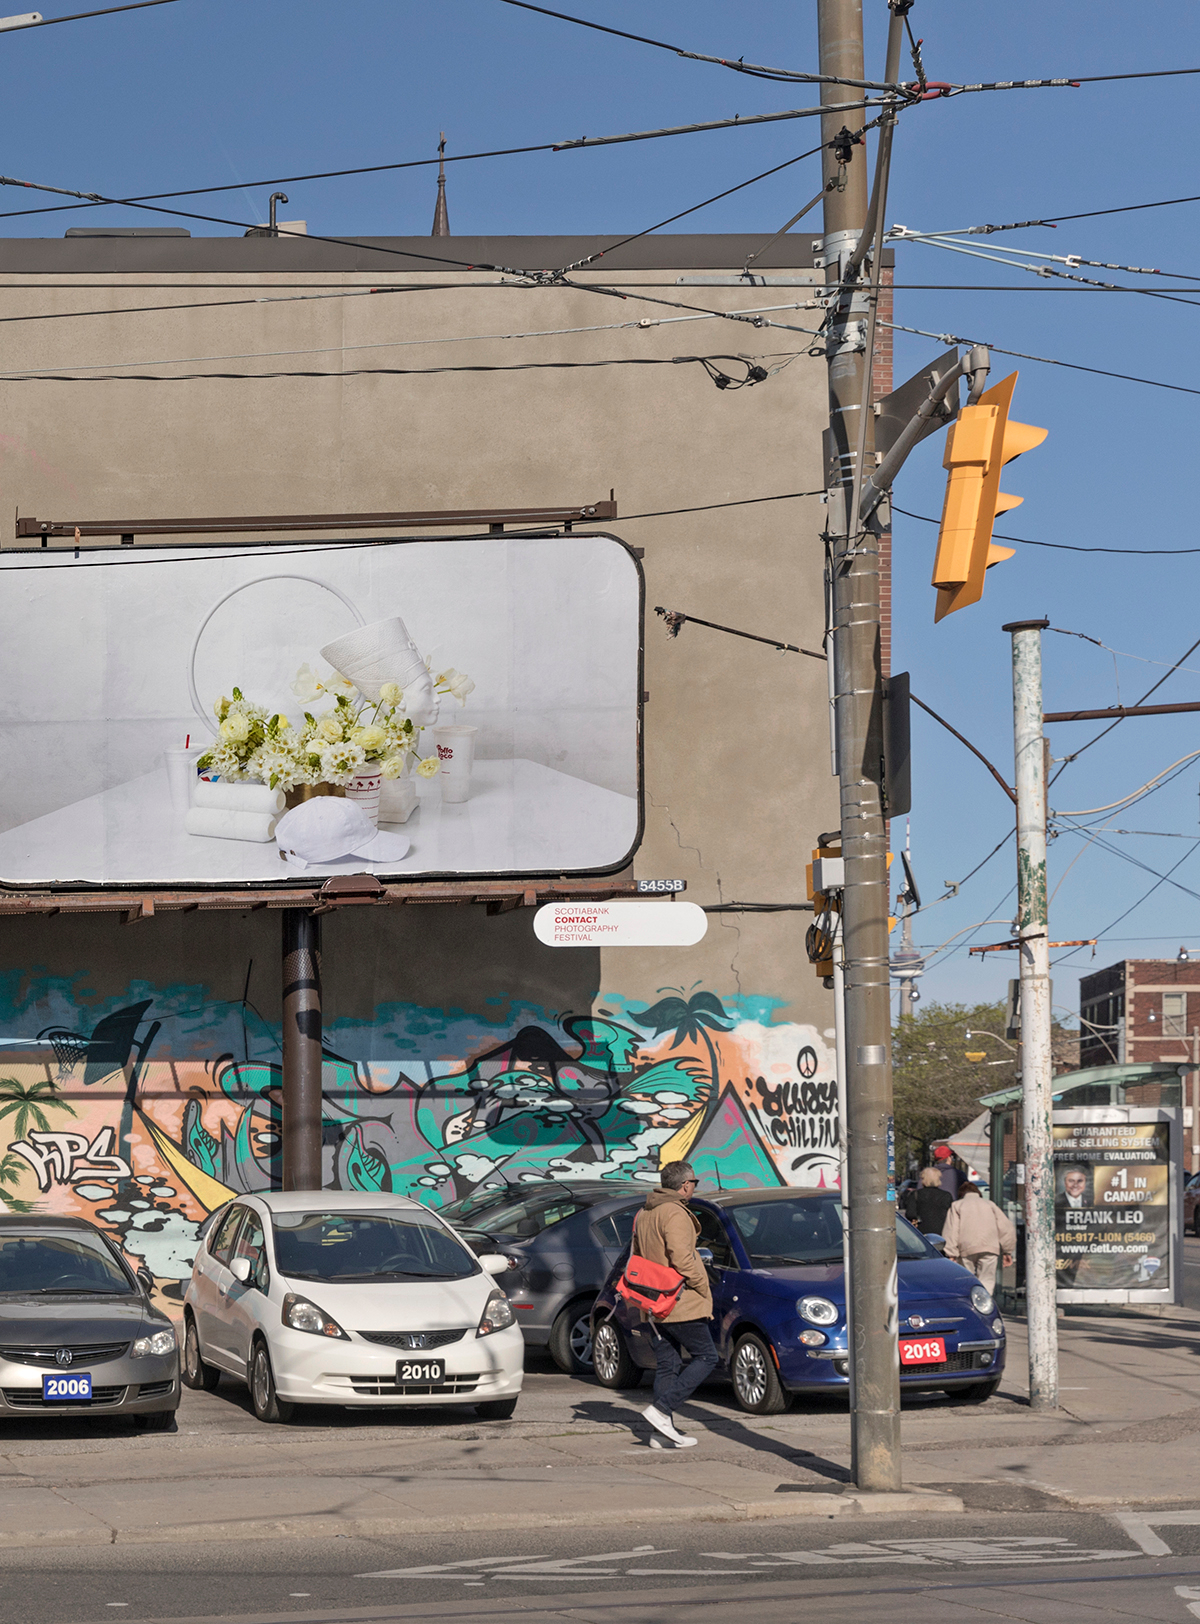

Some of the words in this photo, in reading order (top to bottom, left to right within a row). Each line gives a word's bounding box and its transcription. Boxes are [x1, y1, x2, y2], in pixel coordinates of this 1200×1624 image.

[640, 880, 684, 892] 5455B
[554, 907, 610, 915] SCOTIABANK
[554, 916, 598, 924] CONTACT
[554, 925, 619, 933] PHOTOGRAPHY
[554, 933, 593, 941] FESTIVAL
[1073, 1126, 1137, 1137] GUARANTEED
[1079, 1138, 1119, 1148] SELLING
[1121, 1137, 1160, 1147] SYSTEM
[1053, 1152, 1075, 1161] FREE
[1076, 1152, 1101, 1161] HOME
[1103, 1151, 1157, 1161] EVALUATION
[1110, 1168, 1128, 1189] #1
[1134, 1177, 1147, 1188] IN
[1065, 1210, 1113, 1224] FRANK
[1116, 1210, 1144, 1224] LEO
[1054, 1232, 1122, 1242] 416-917-LION
[1124, 1232, 1156, 1244] (5466)
[1061, 1243, 1149, 1254] www.GetLeo.com
[903, 1342, 941, 1359] 2013
[401, 1364, 441, 1380] 2010
[47, 1379, 90, 1395] 2006
